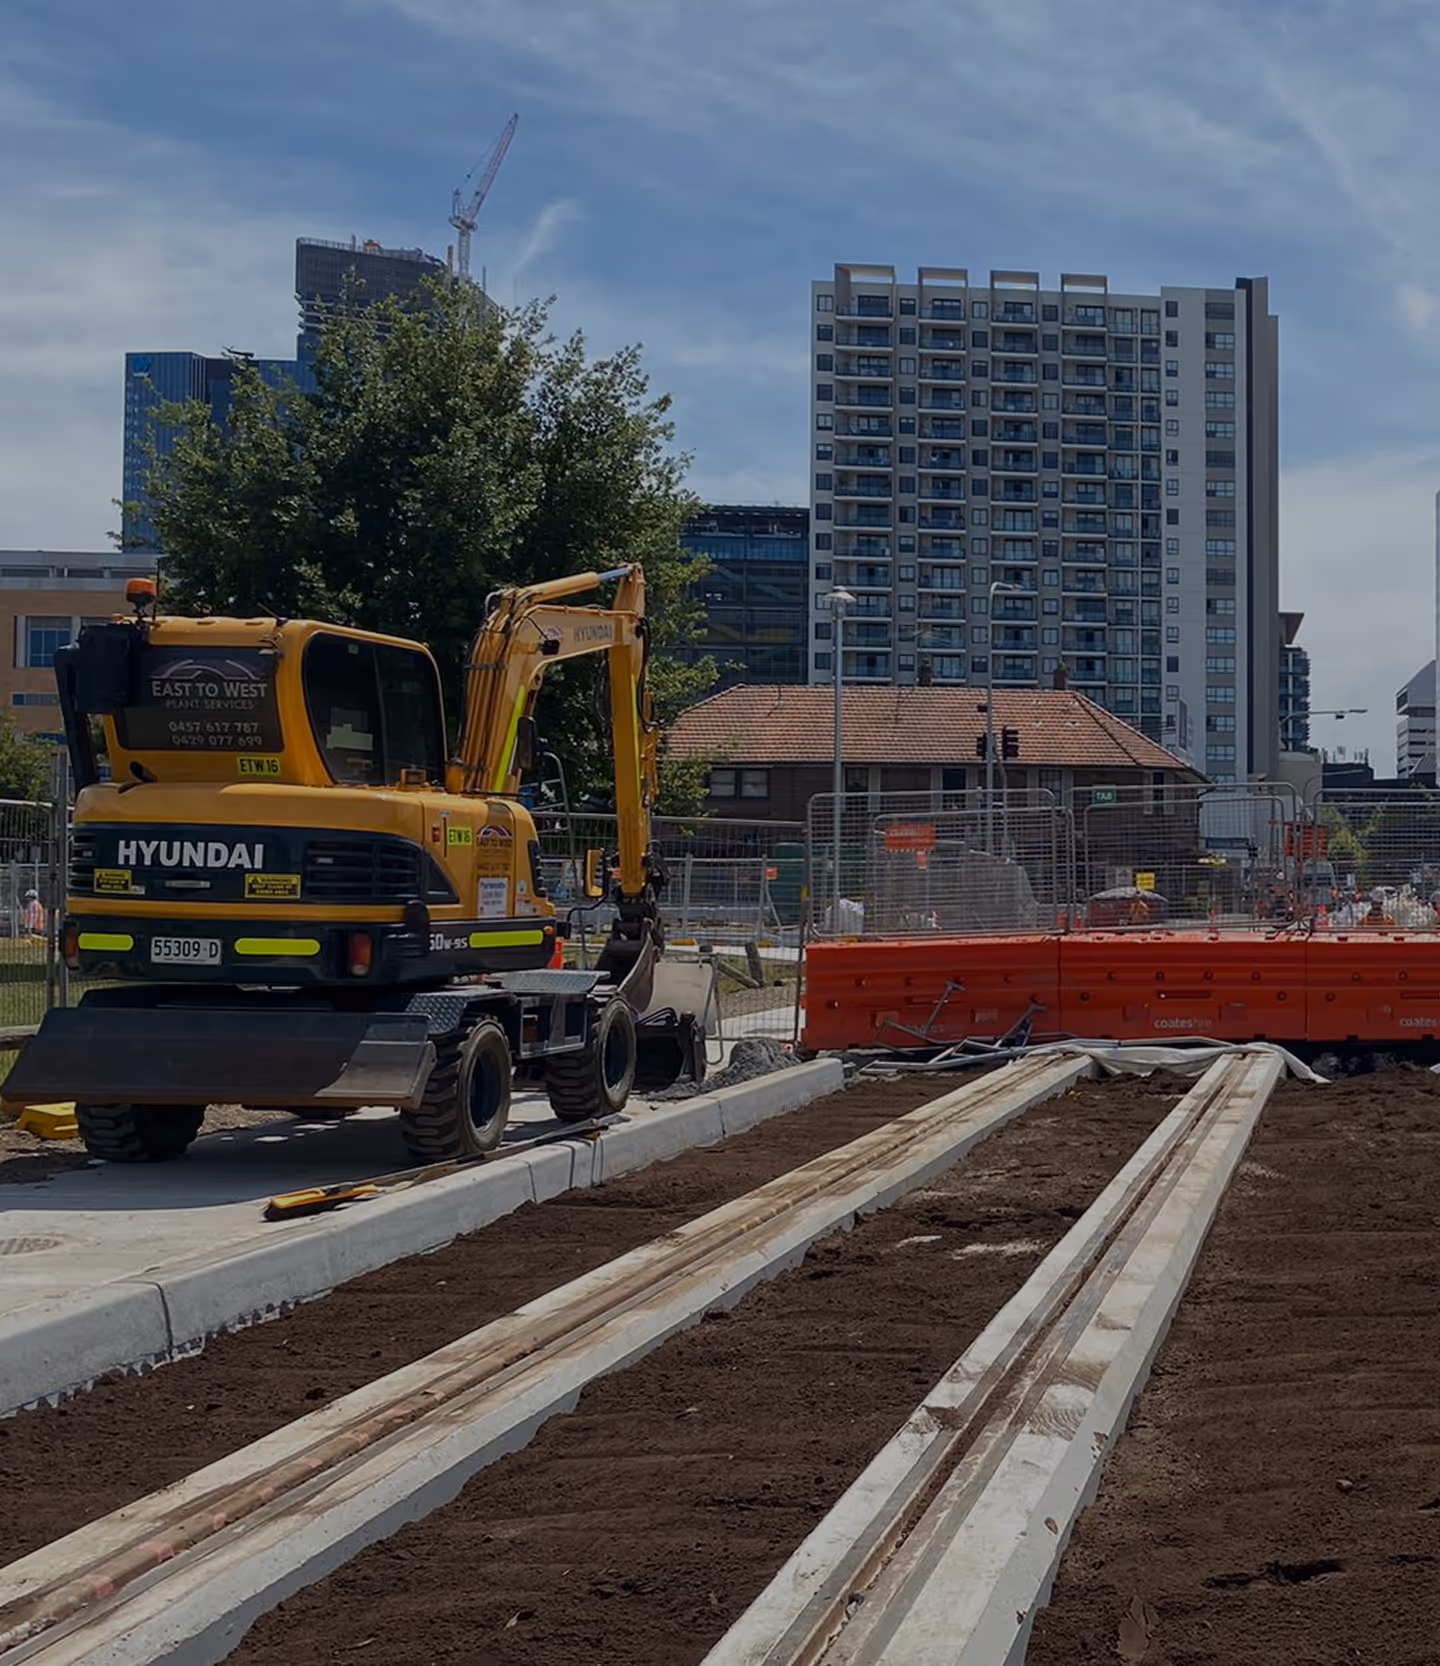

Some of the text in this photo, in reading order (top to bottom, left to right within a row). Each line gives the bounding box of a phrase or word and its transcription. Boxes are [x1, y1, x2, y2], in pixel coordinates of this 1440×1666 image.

[573, 624, 613, 642] HYUNDAI
[151, 681, 268, 698] EAST TO WEST
[204, 699, 256, 711] SERVICES
[234, 722, 259, 734] 787
[117, 839, 265, 870] HYUNDAI
